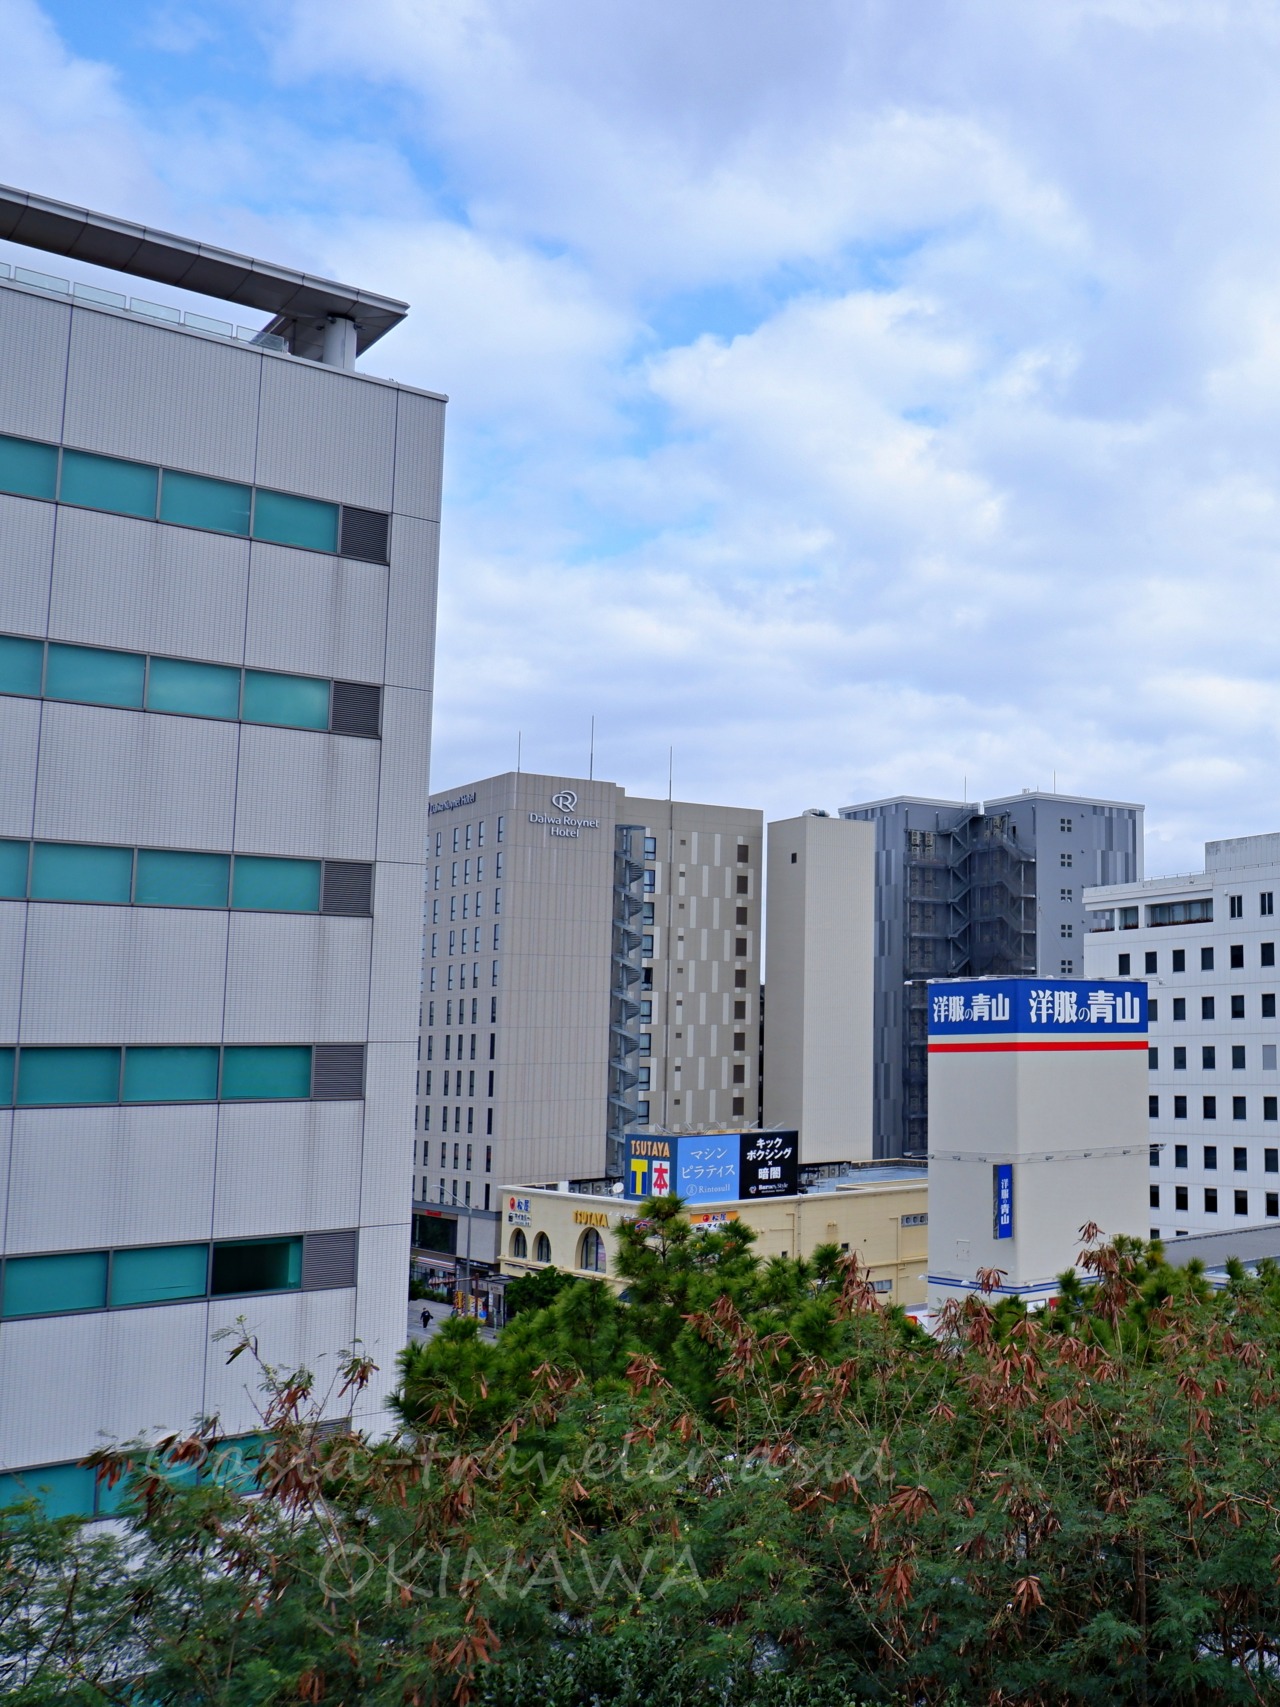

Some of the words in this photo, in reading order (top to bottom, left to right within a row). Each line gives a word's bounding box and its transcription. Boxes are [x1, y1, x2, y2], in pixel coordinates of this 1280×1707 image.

[529, 812, 562, 825] Daiwa
[563, 815, 600, 829] Roynet
[550, 825, 580, 839] Hotel
[932, 993, 1010, 1023] 洋服の青山
[1029, 989, 1140, 1024] 洋服の青山
[630, 1139, 671, 1158] TSUTAYA
[755, 1137, 783, 1149] キック
[690, 1147, 729, 1161] マシン
[746, 1147, 793, 1162] ボクシング
[681, 1164, 736, 1180] ピラティス
[757, 1166, 782, 1180] 暗闇
[698, 1184, 731, 1194] Rintosull
[1001, 1178, 1010, 1225] 洋服の青山
[573, 1210, 610, 1228] TSUTAYA
[711, 1213, 727, 1221] 松屋
